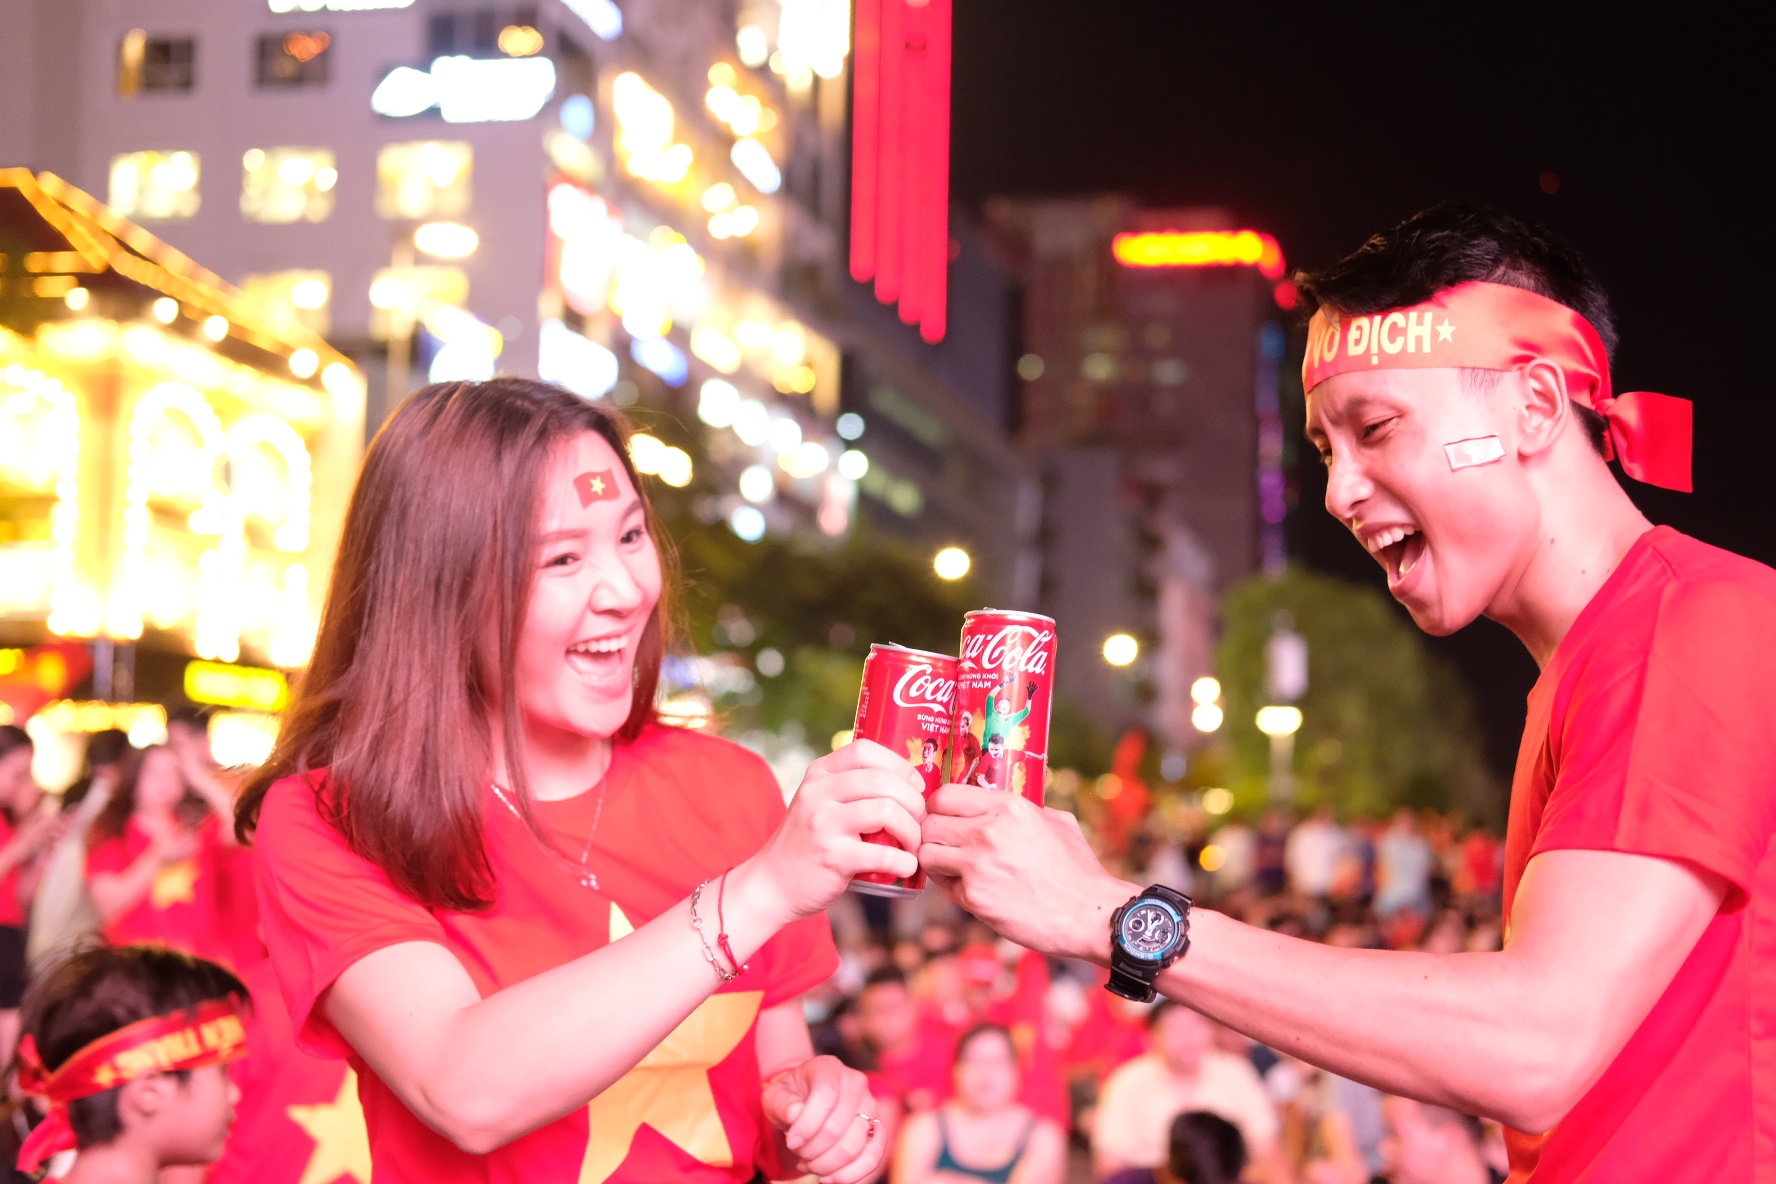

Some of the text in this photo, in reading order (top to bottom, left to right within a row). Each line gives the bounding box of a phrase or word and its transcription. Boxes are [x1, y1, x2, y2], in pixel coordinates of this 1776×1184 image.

[1347, 311, 1433, 365] ĐỊCH
[961, 625, 1054, 674] ca-Cola
[972, 680, 992, 689] NAM
